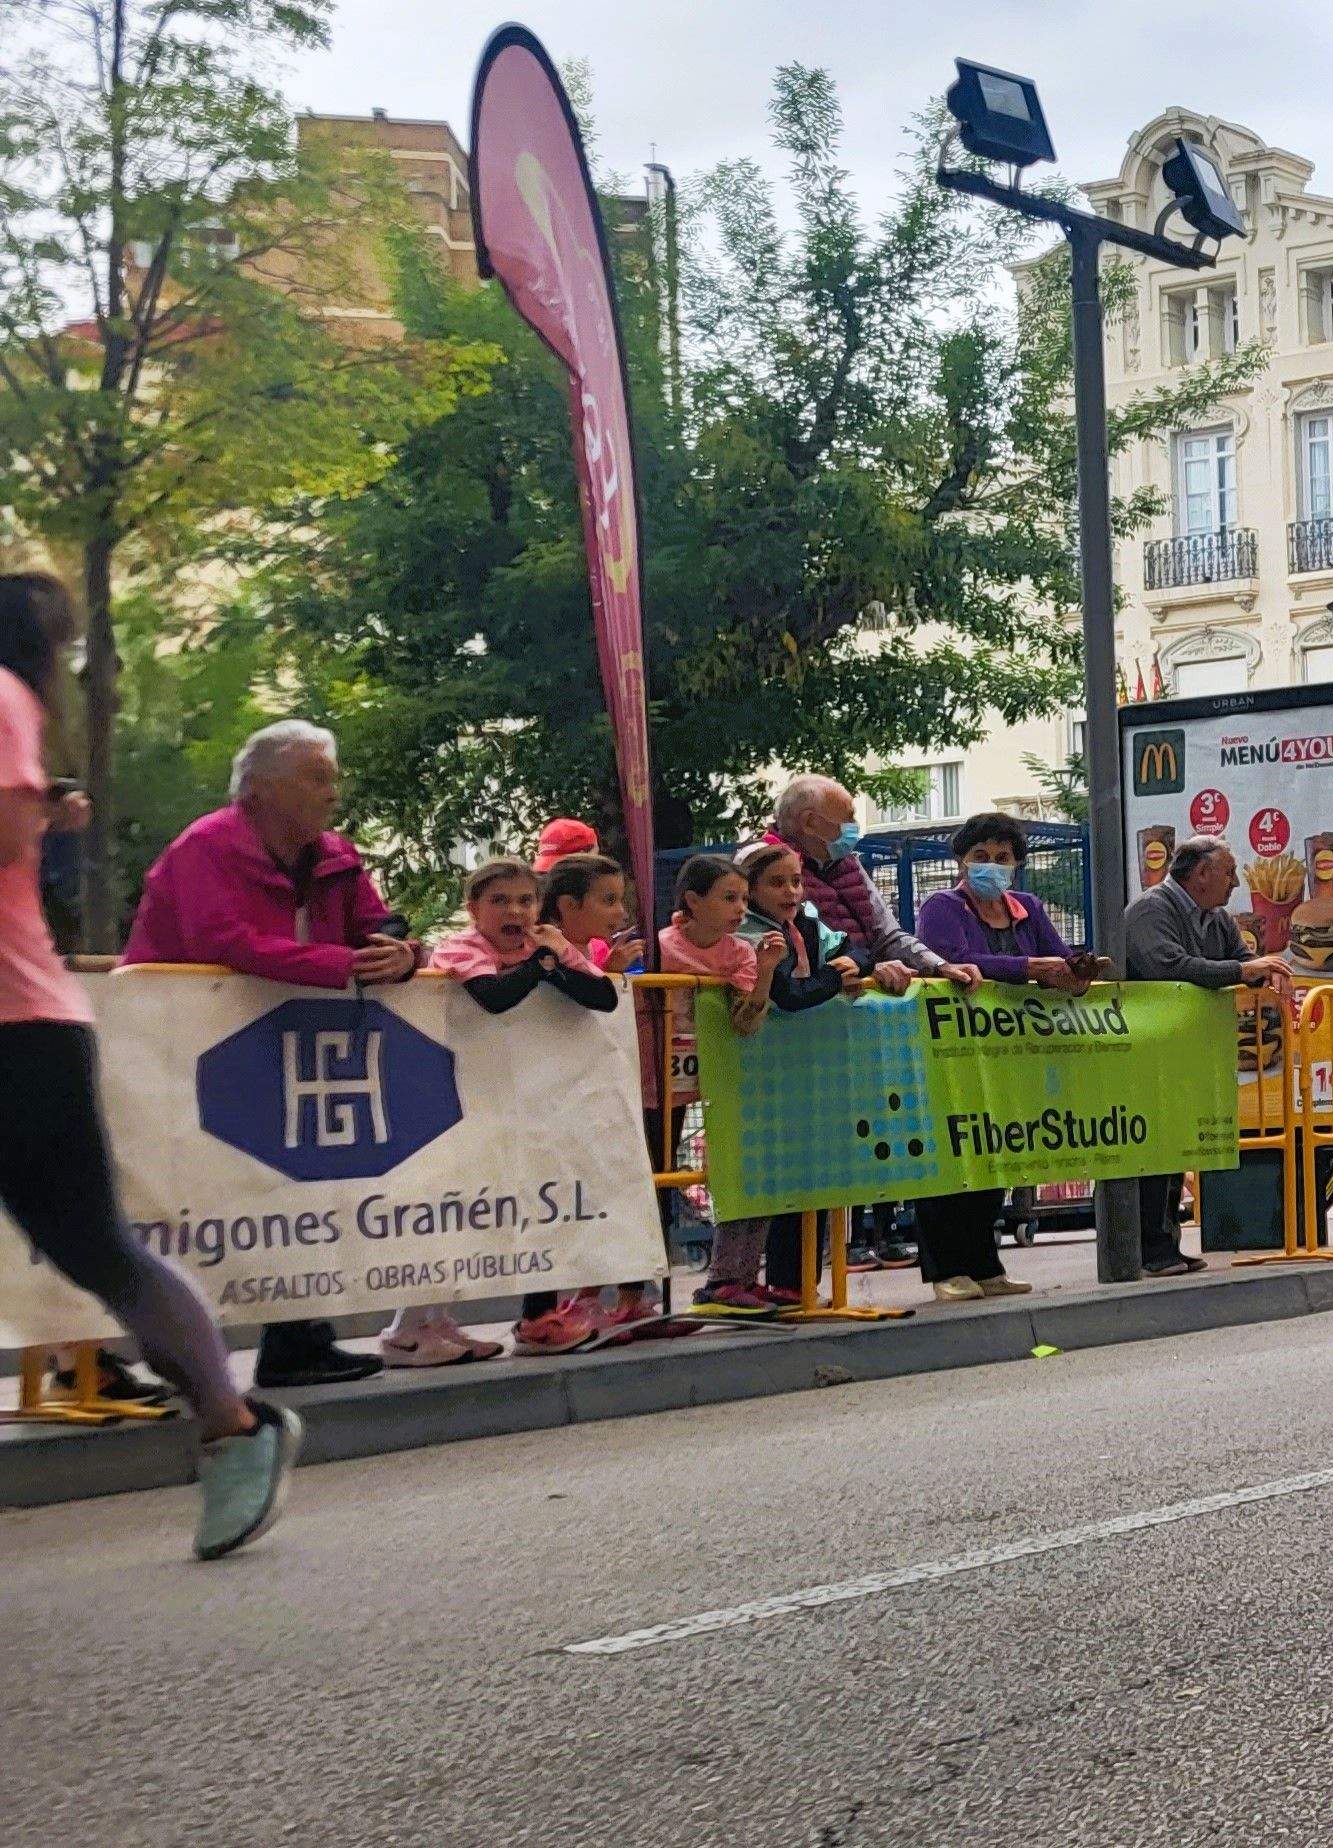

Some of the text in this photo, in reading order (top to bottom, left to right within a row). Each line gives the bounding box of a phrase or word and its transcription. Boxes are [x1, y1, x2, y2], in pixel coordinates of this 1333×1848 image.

[1213, 696, 1255, 709] URBAN
[1220, 736, 1280, 767] MENÚ
[1221, 735, 1249, 745] Nuevo
[1256, 843, 1282, 853] Doble
[925, 997, 1130, 1040] FiberSalud
[946, 1105, 1147, 1158] FiberStudio
[356, 1186, 530, 1240] Grañén,
[537, 1179, 609, 1225] S.L.
[219, 1251, 555, 1305] ASFALTOS OBRAS PÚBLICAS
